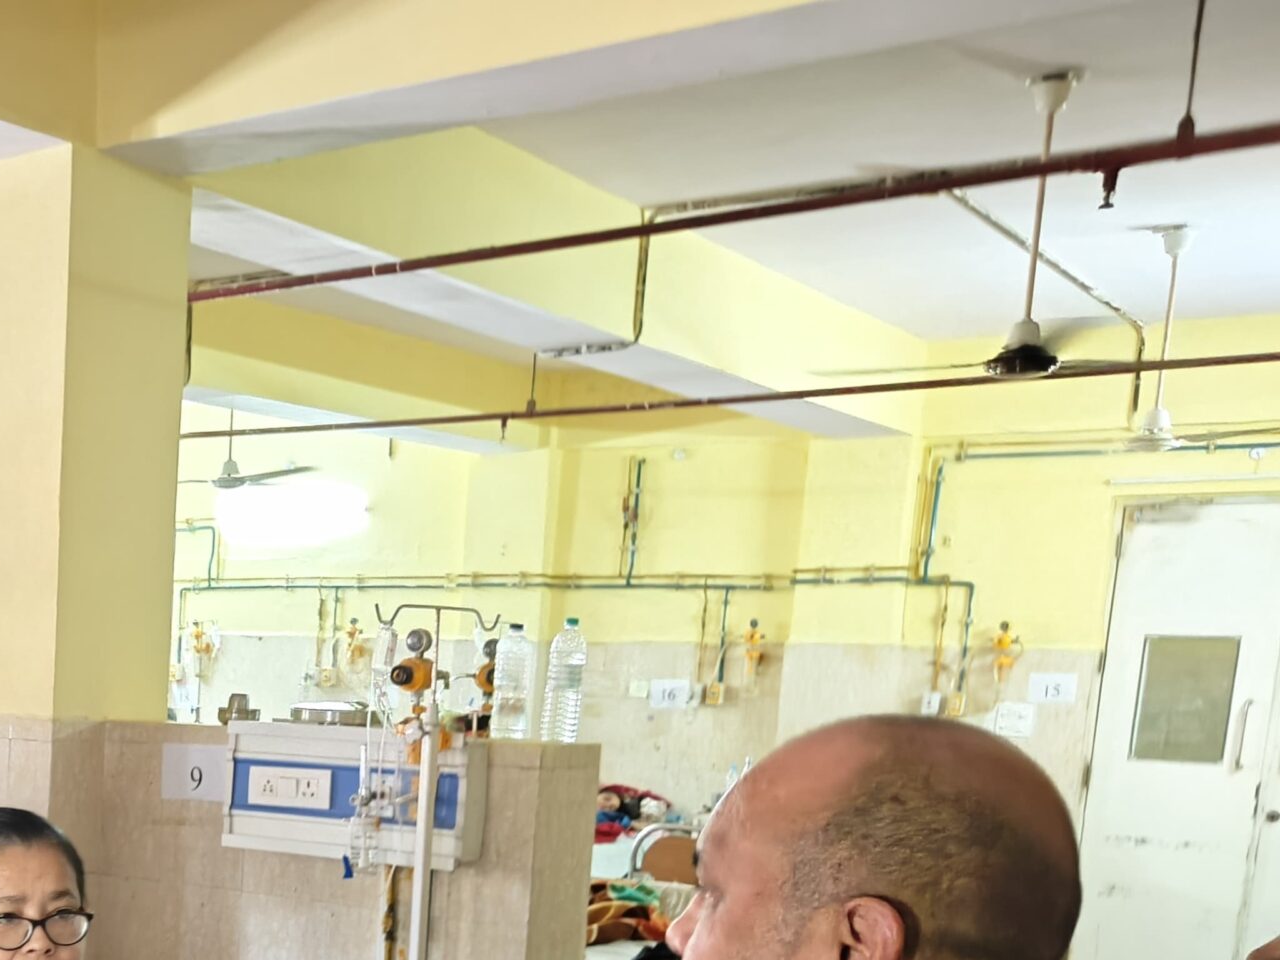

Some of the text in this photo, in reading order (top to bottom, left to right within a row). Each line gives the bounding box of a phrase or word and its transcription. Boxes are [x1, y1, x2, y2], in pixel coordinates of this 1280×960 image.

[662, 687, 676, 702] 16
[1045, 683, 1061, 699] 15
[190, 766, 203, 791] 9
